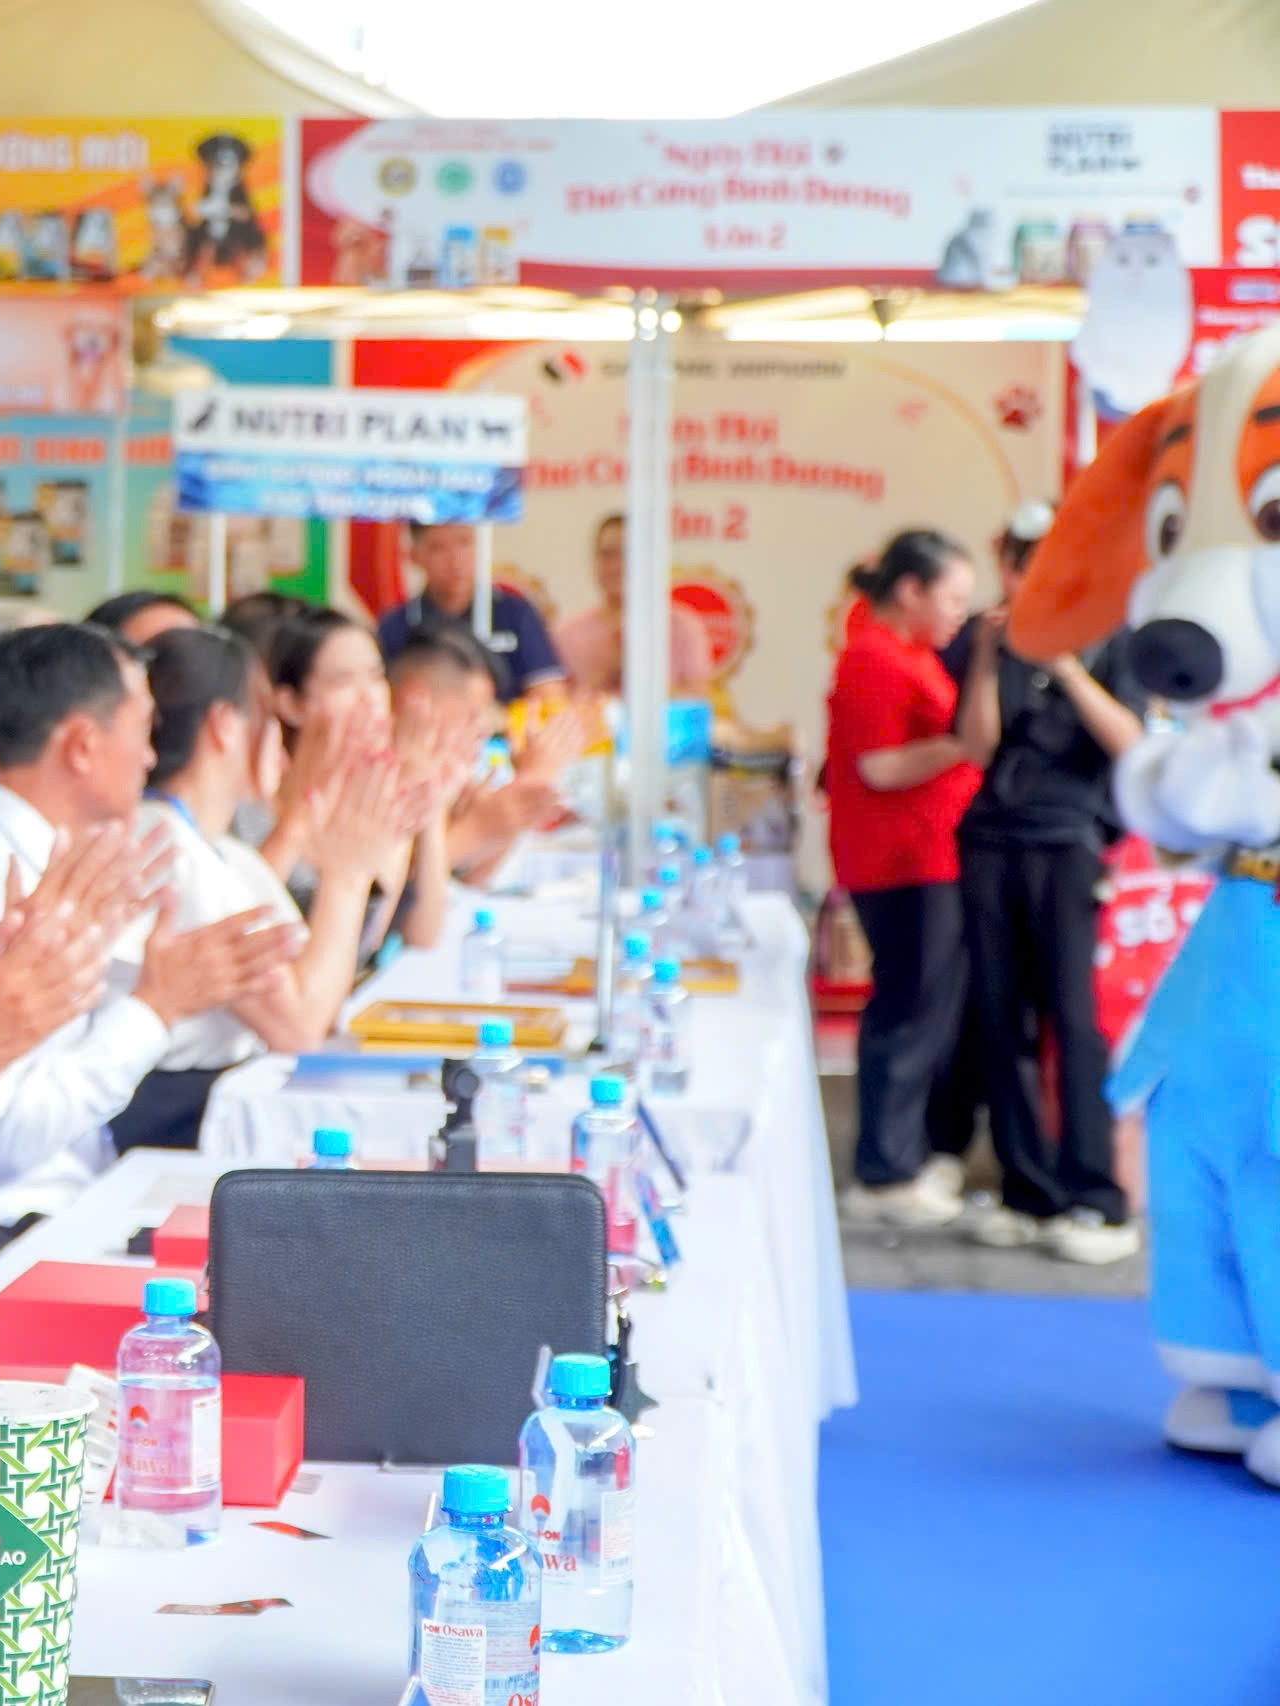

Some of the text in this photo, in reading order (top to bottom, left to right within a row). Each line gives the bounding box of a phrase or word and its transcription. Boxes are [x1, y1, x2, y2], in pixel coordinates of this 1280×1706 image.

[232, 406, 468, 443] NUTRI PLAN
[442, 1624, 484, 1638] Osawa
